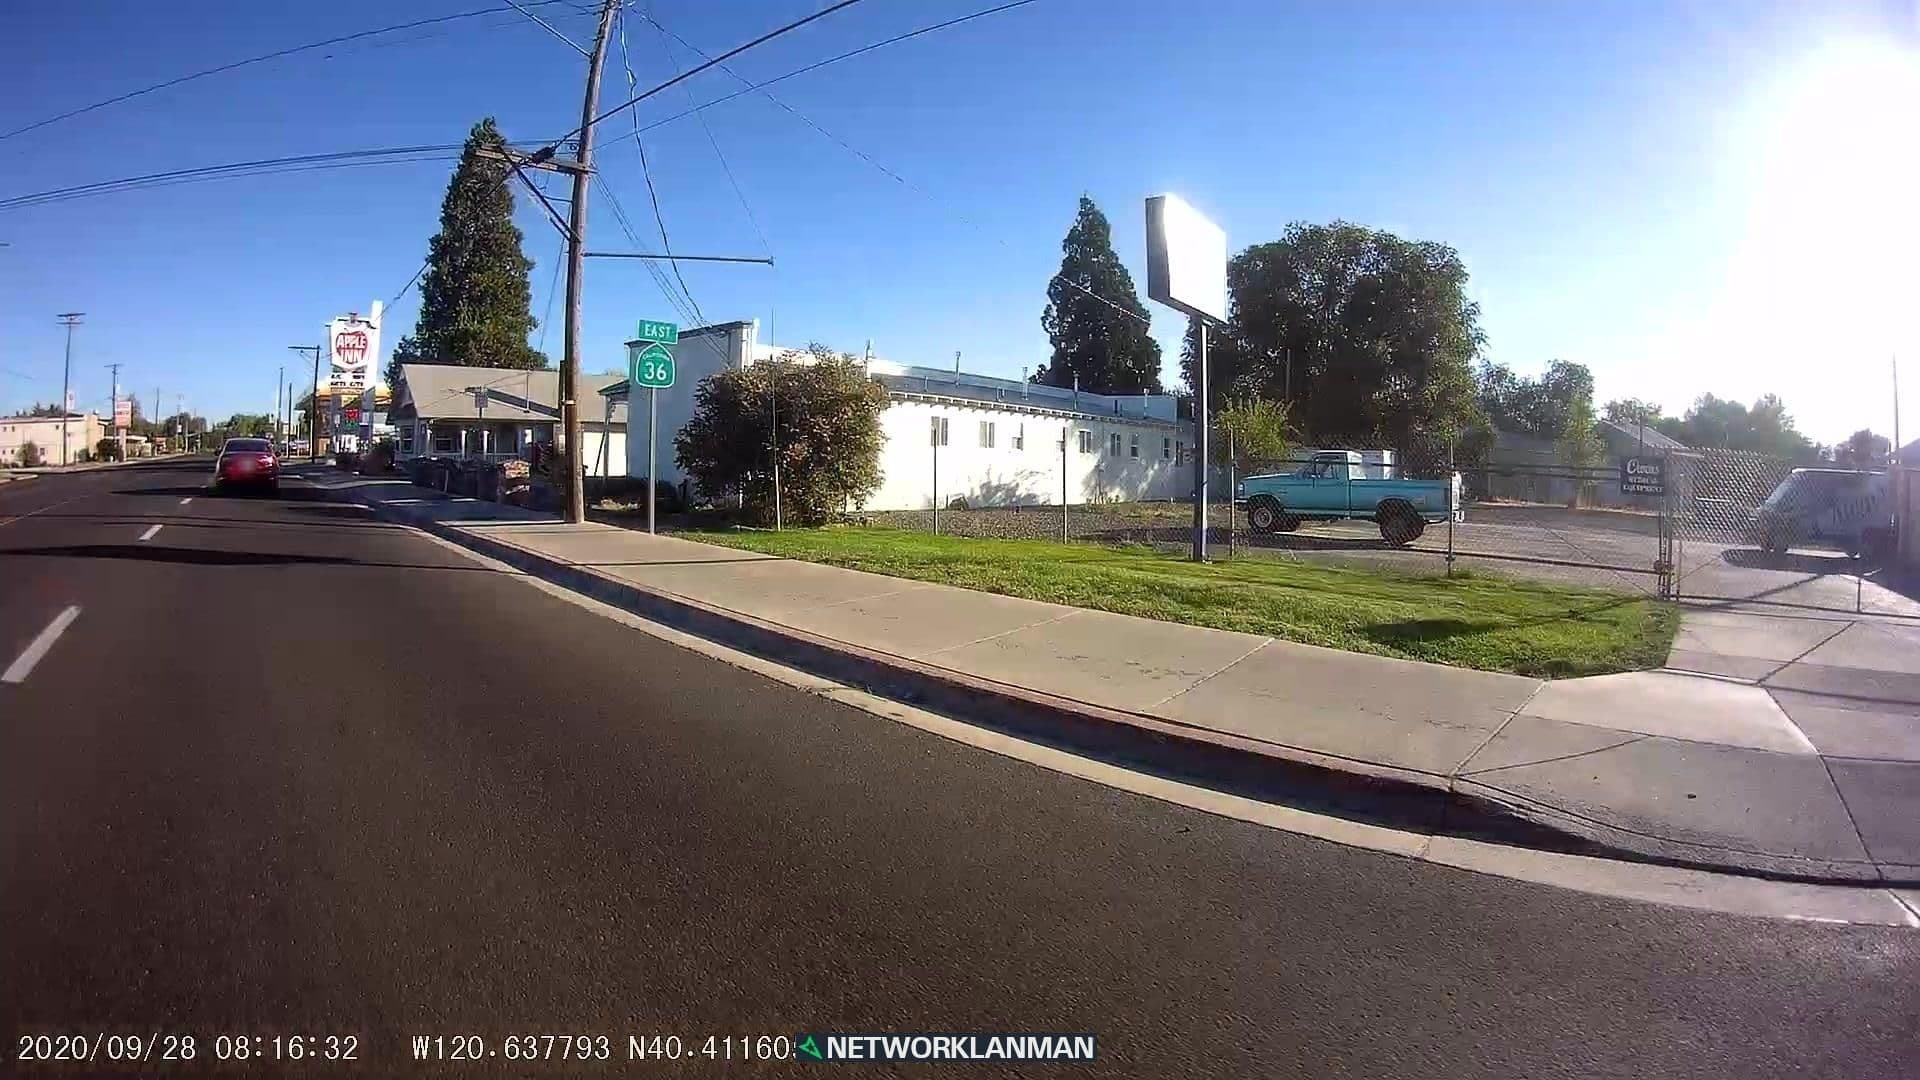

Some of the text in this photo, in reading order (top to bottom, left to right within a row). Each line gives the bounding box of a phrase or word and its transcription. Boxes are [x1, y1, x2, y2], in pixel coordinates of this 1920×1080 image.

[644, 323, 672, 338] EAST
[336, 334, 367, 349] APPLE
[340, 349, 364, 362] INN
[644, 361, 667, 381] 36
